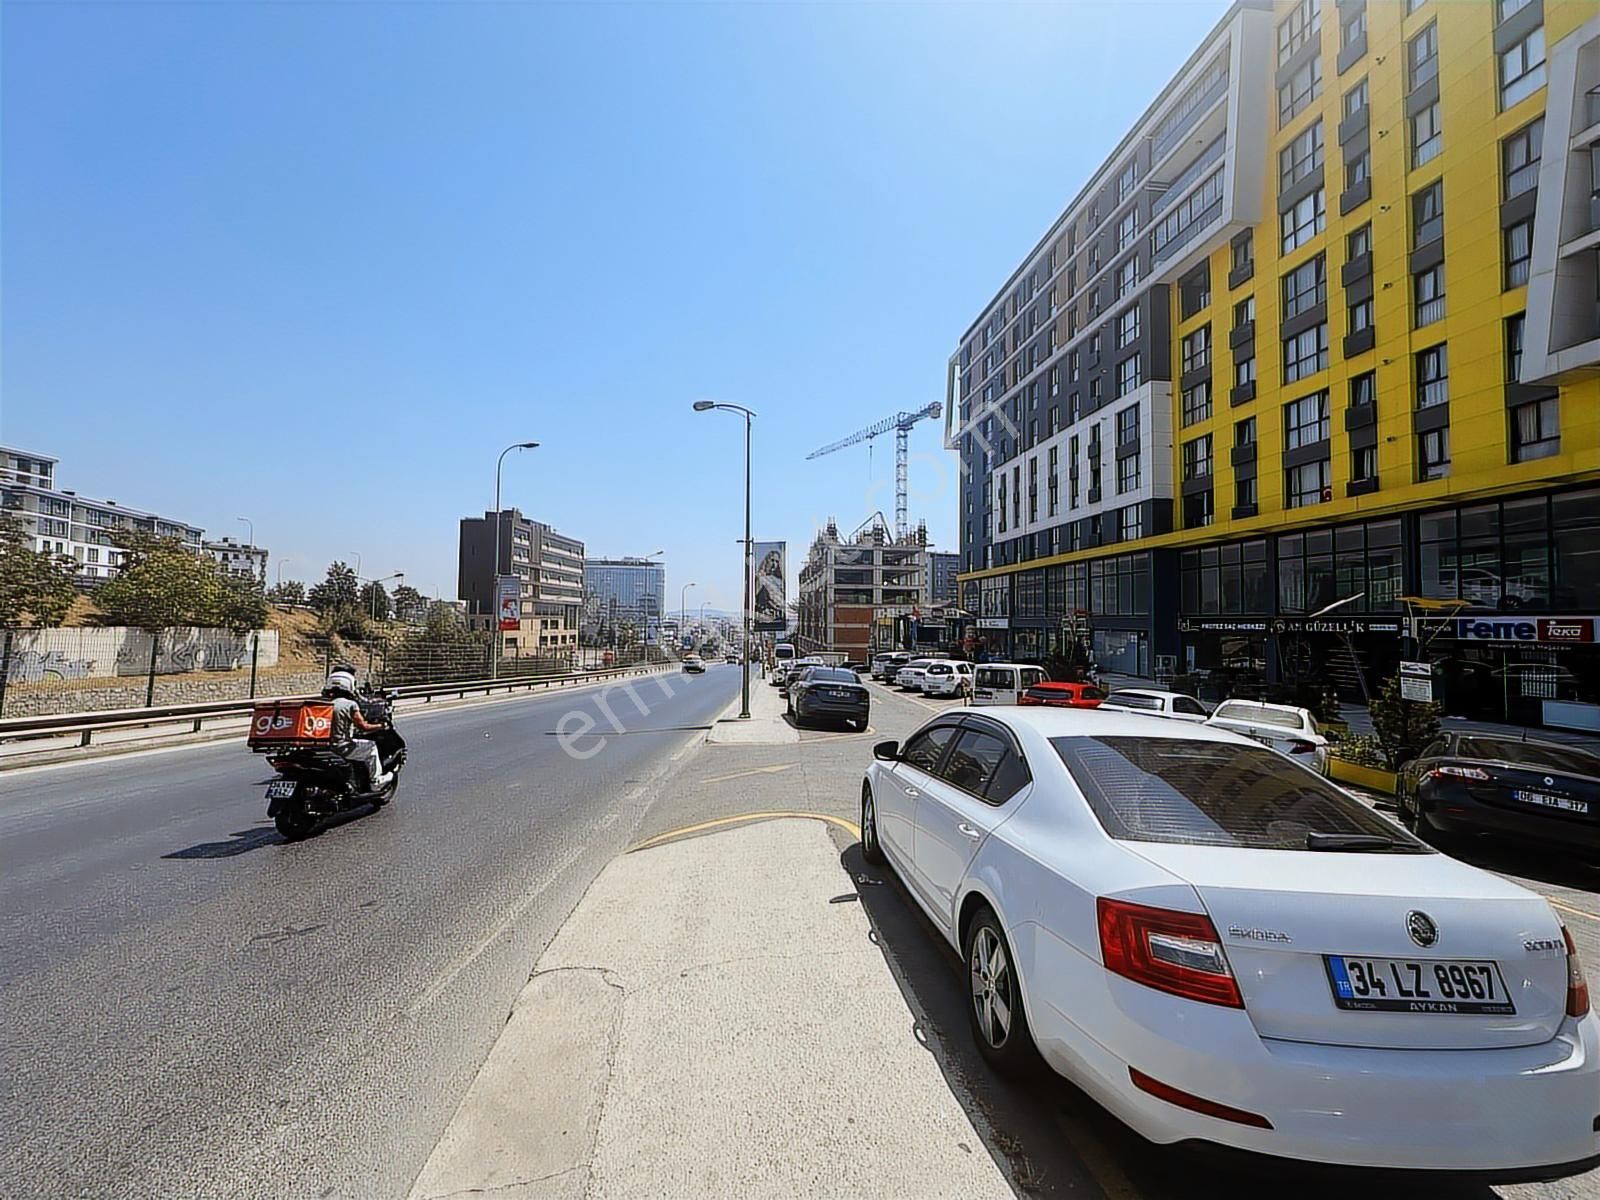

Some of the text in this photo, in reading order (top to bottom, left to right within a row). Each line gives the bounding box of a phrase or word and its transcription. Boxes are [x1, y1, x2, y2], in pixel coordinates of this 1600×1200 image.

[1348, 962, 1387, 997] 34
[1390, 962, 1431, 999] LZ
[1434, 964, 1497, 1001] 8967
[1410, 1002, 1458, 1013] AYKAN
